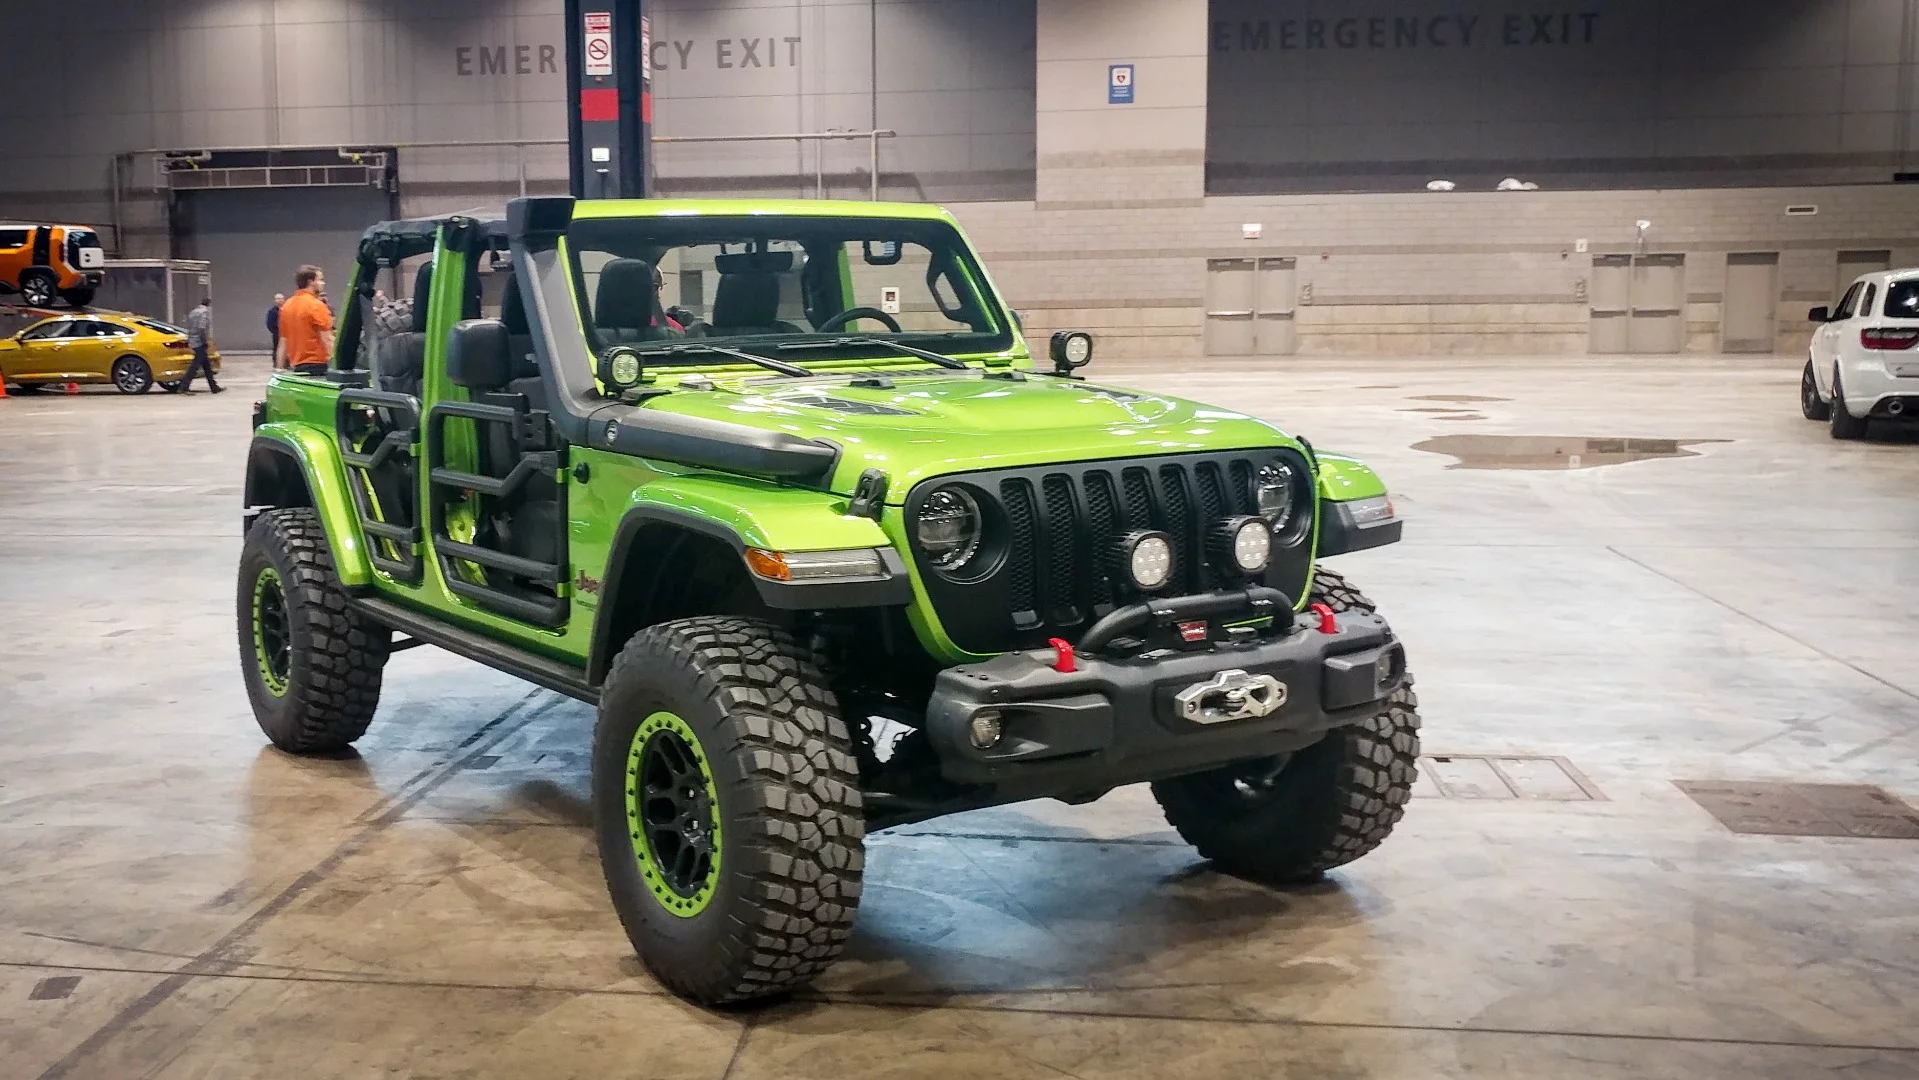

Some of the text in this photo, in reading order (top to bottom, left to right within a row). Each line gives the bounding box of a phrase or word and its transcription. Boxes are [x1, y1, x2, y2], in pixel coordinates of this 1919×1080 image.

[1213, 13, 1600, 52] EMERGENCY EXIT
[456, 41, 693, 76] EMERCY
[717, 37, 801, 69] EXIT
